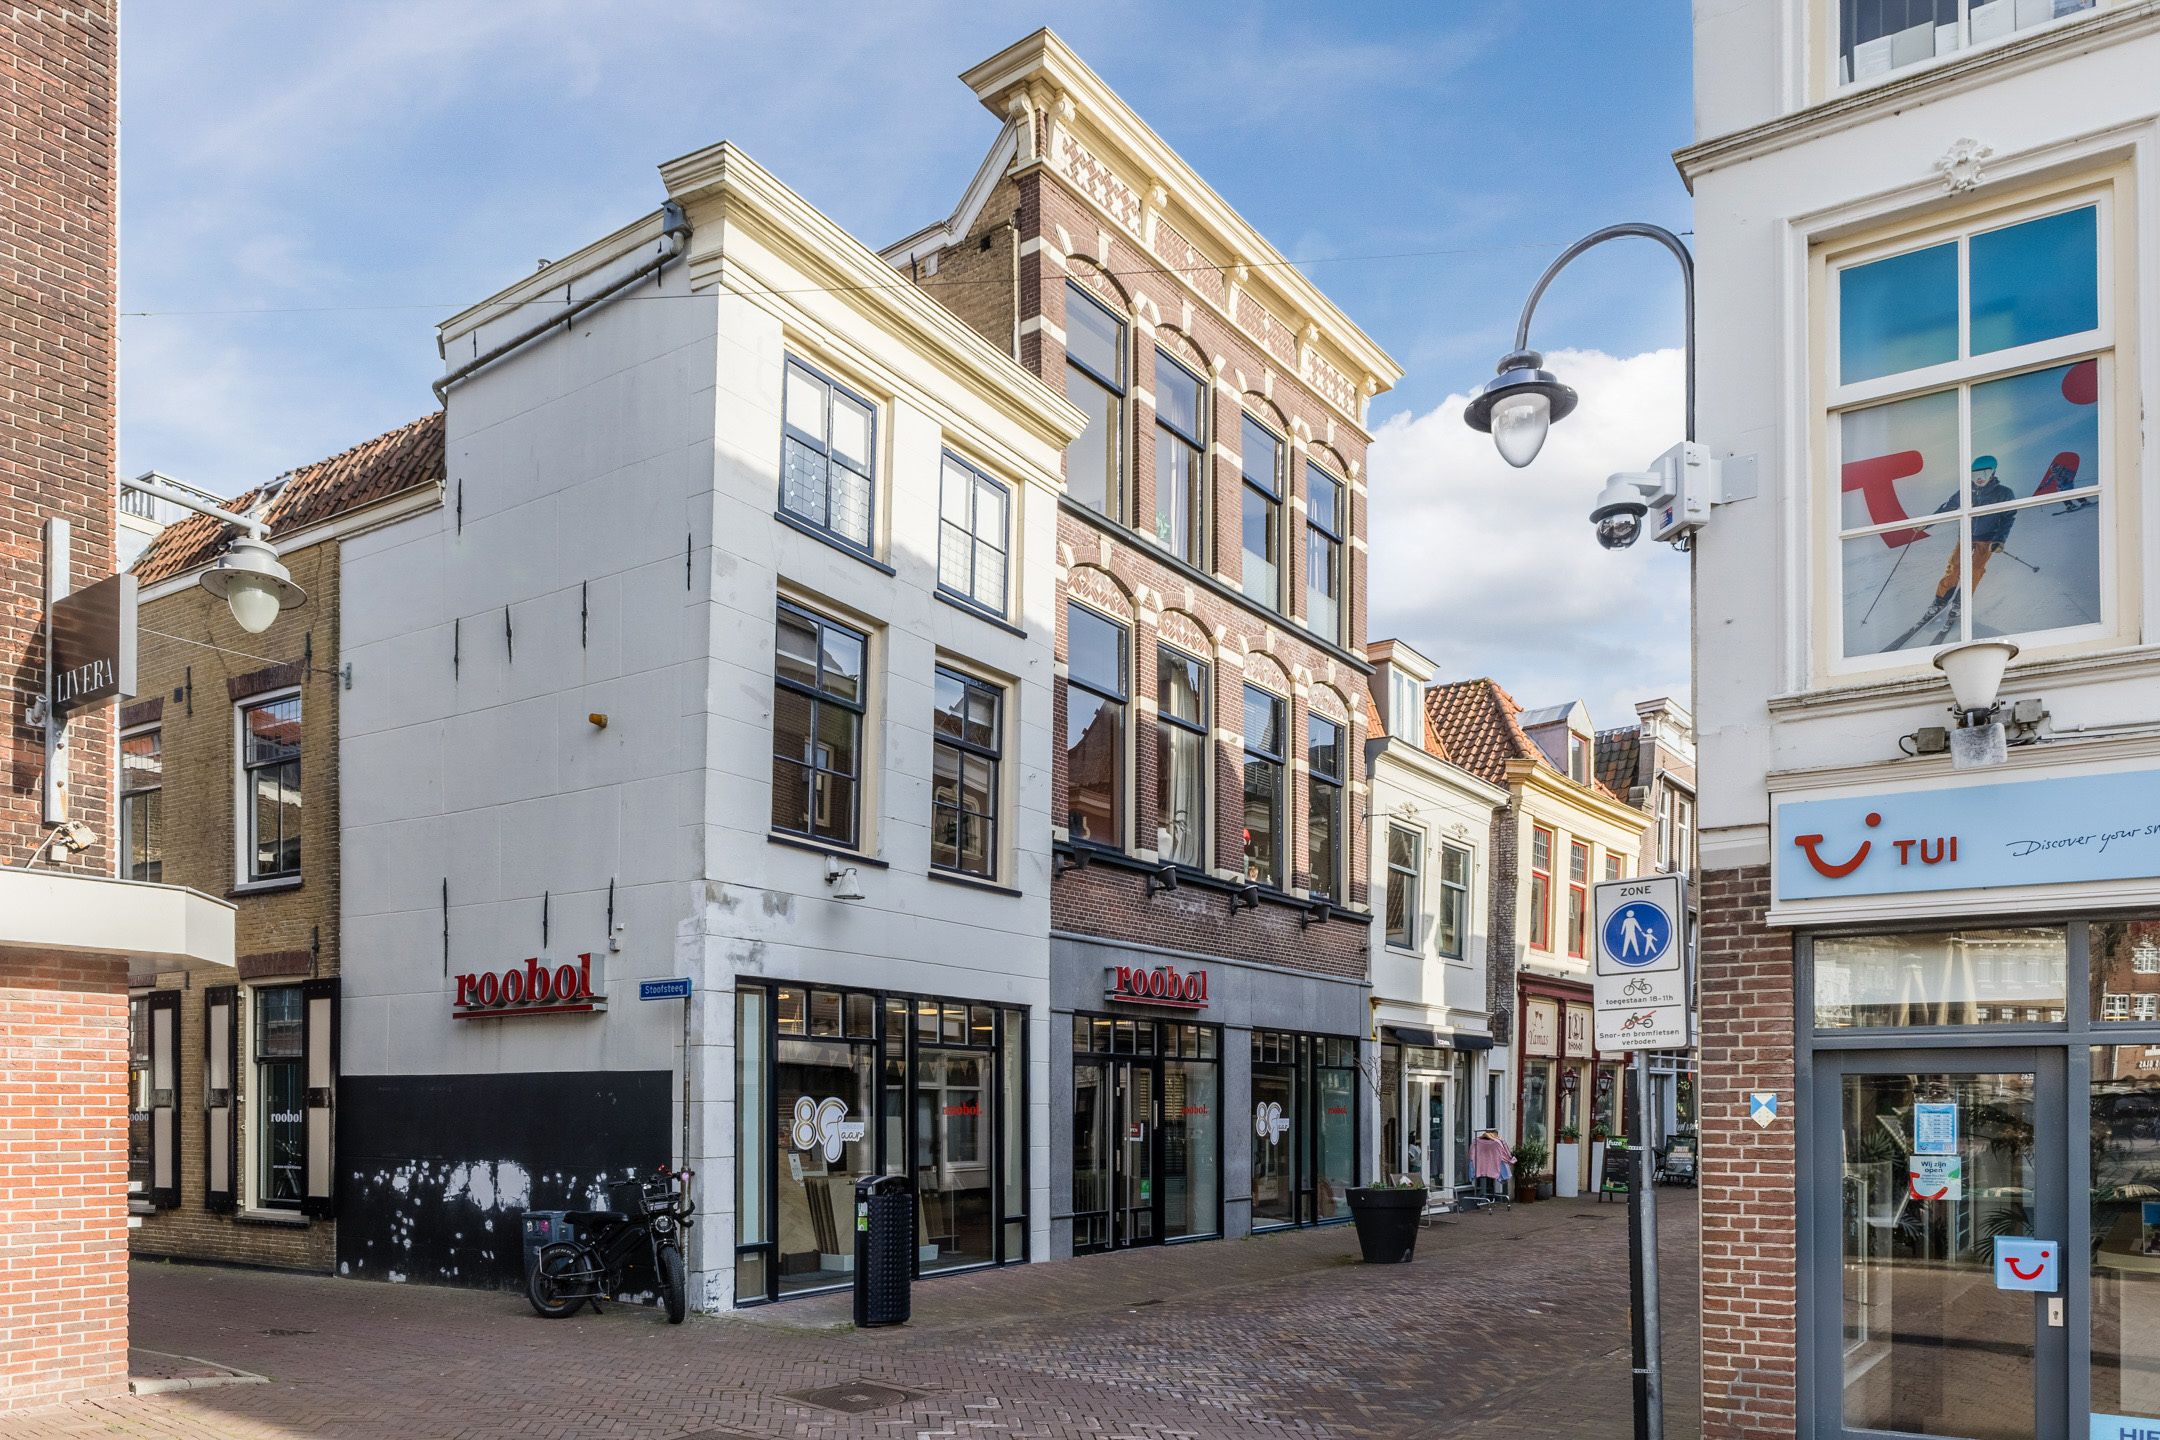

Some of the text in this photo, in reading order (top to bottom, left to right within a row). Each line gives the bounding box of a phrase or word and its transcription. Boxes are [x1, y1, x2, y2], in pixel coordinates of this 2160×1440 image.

[56, 657, 115, 703] LIVERA
[1893, 836, 1957, 865] TUI
[2006, 835, 2096, 856] Discover
[2099, 829, 2141, 853] your
[1620, 885, 1651, 897] ZONE
[455, 953, 594, 1007] roobol
[645, 985, 683, 994] Stoofsteeg
[1112, 965, 1208, 1001] roobol
[1606, 996, 1647, 1005] toegestaan
[1634, 1029, 1679, 1037] bromfietsen
[271, 1110, 302, 1122] roobol
